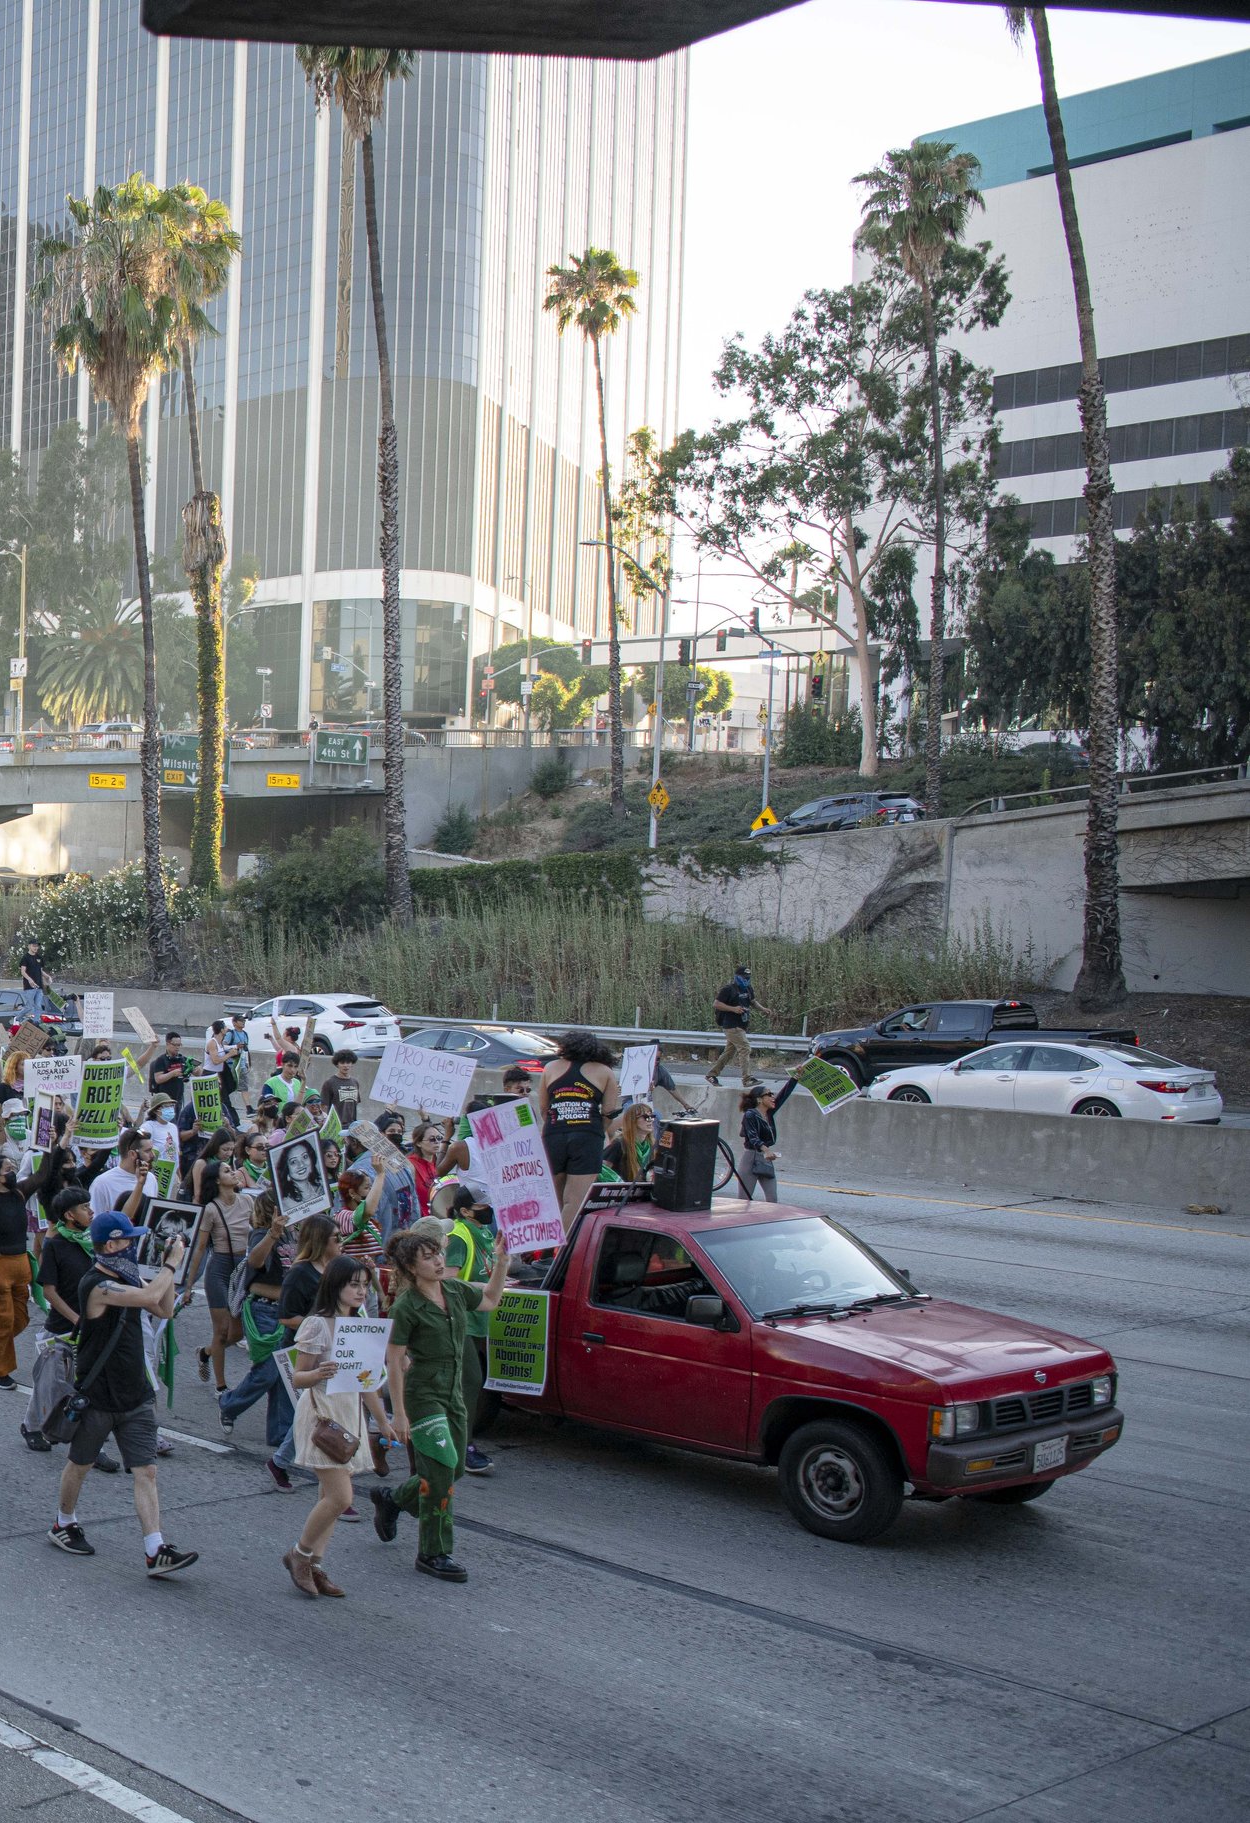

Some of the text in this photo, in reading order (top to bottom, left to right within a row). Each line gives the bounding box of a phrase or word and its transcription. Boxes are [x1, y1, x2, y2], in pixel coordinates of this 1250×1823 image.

[328, 737, 344, 746] EAST
[321, 748, 351, 759] 4th St
[162, 758, 200, 770] Wilshire
[91, 776, 100, 784] 15
[111, 777, 117, 786] 2
[166, 773, 183, 782] EXIT
[269, 776, 277, 785] 15
[286, 776, 292, 786] 3
[32, 1059, 76, 1069] KEEP YOUR
[394, 1044, 474, 1078] PRO CHOICE
[806, 1062, 817, 1072] the
[36, 1068, 70, 1076] ROSARIES
[84, 1065, 124, 1080] OVERTURN
[811, 1072, 828, 1082] Court
[38, 1080, 78, 1090] OVARIES!
[388, 1066, 452, 1094] PRO ROE
[816, 1078, 843, 1096] Abortion
[825, 1084, 846, 1101] Rights!
[86, 1084, 120, 1104] ROE ?
[380, 1084, 460, 1112] PRO WOMEN
[198, 1094, 219, 1108] ROE
[78, 1110, 106, 1124] HELL
[198, 1112, 218, 1122] HELL
[472, 1111, 504, 1150] MEN
[514, 1138, 534, 1158] 100%
[502, 1160, 544, 1184] ABORTIONS
[160, 1168, 170, 1190] STOP
[500, 1200, 540, 1230] FORCED
[498, 1296, 540, 1310] STOP the
[496, 1310, 540, 1325] Supreme
[338, 1325, 386, 1334] ABORTION
[504, 1325, 531, 1338] Court
[336, 1338, 346, 1346] IS
[506, 1340, 526, 1350] taking
[528, 1342, 546, 1352] away
[335, 1350, 355, 1358] OUR
[495, 1349, 536, 1364] Abortion
[335, 1362, 363, 1370] RIGHT!
[500, 1363, 532, 1378] Rights!
